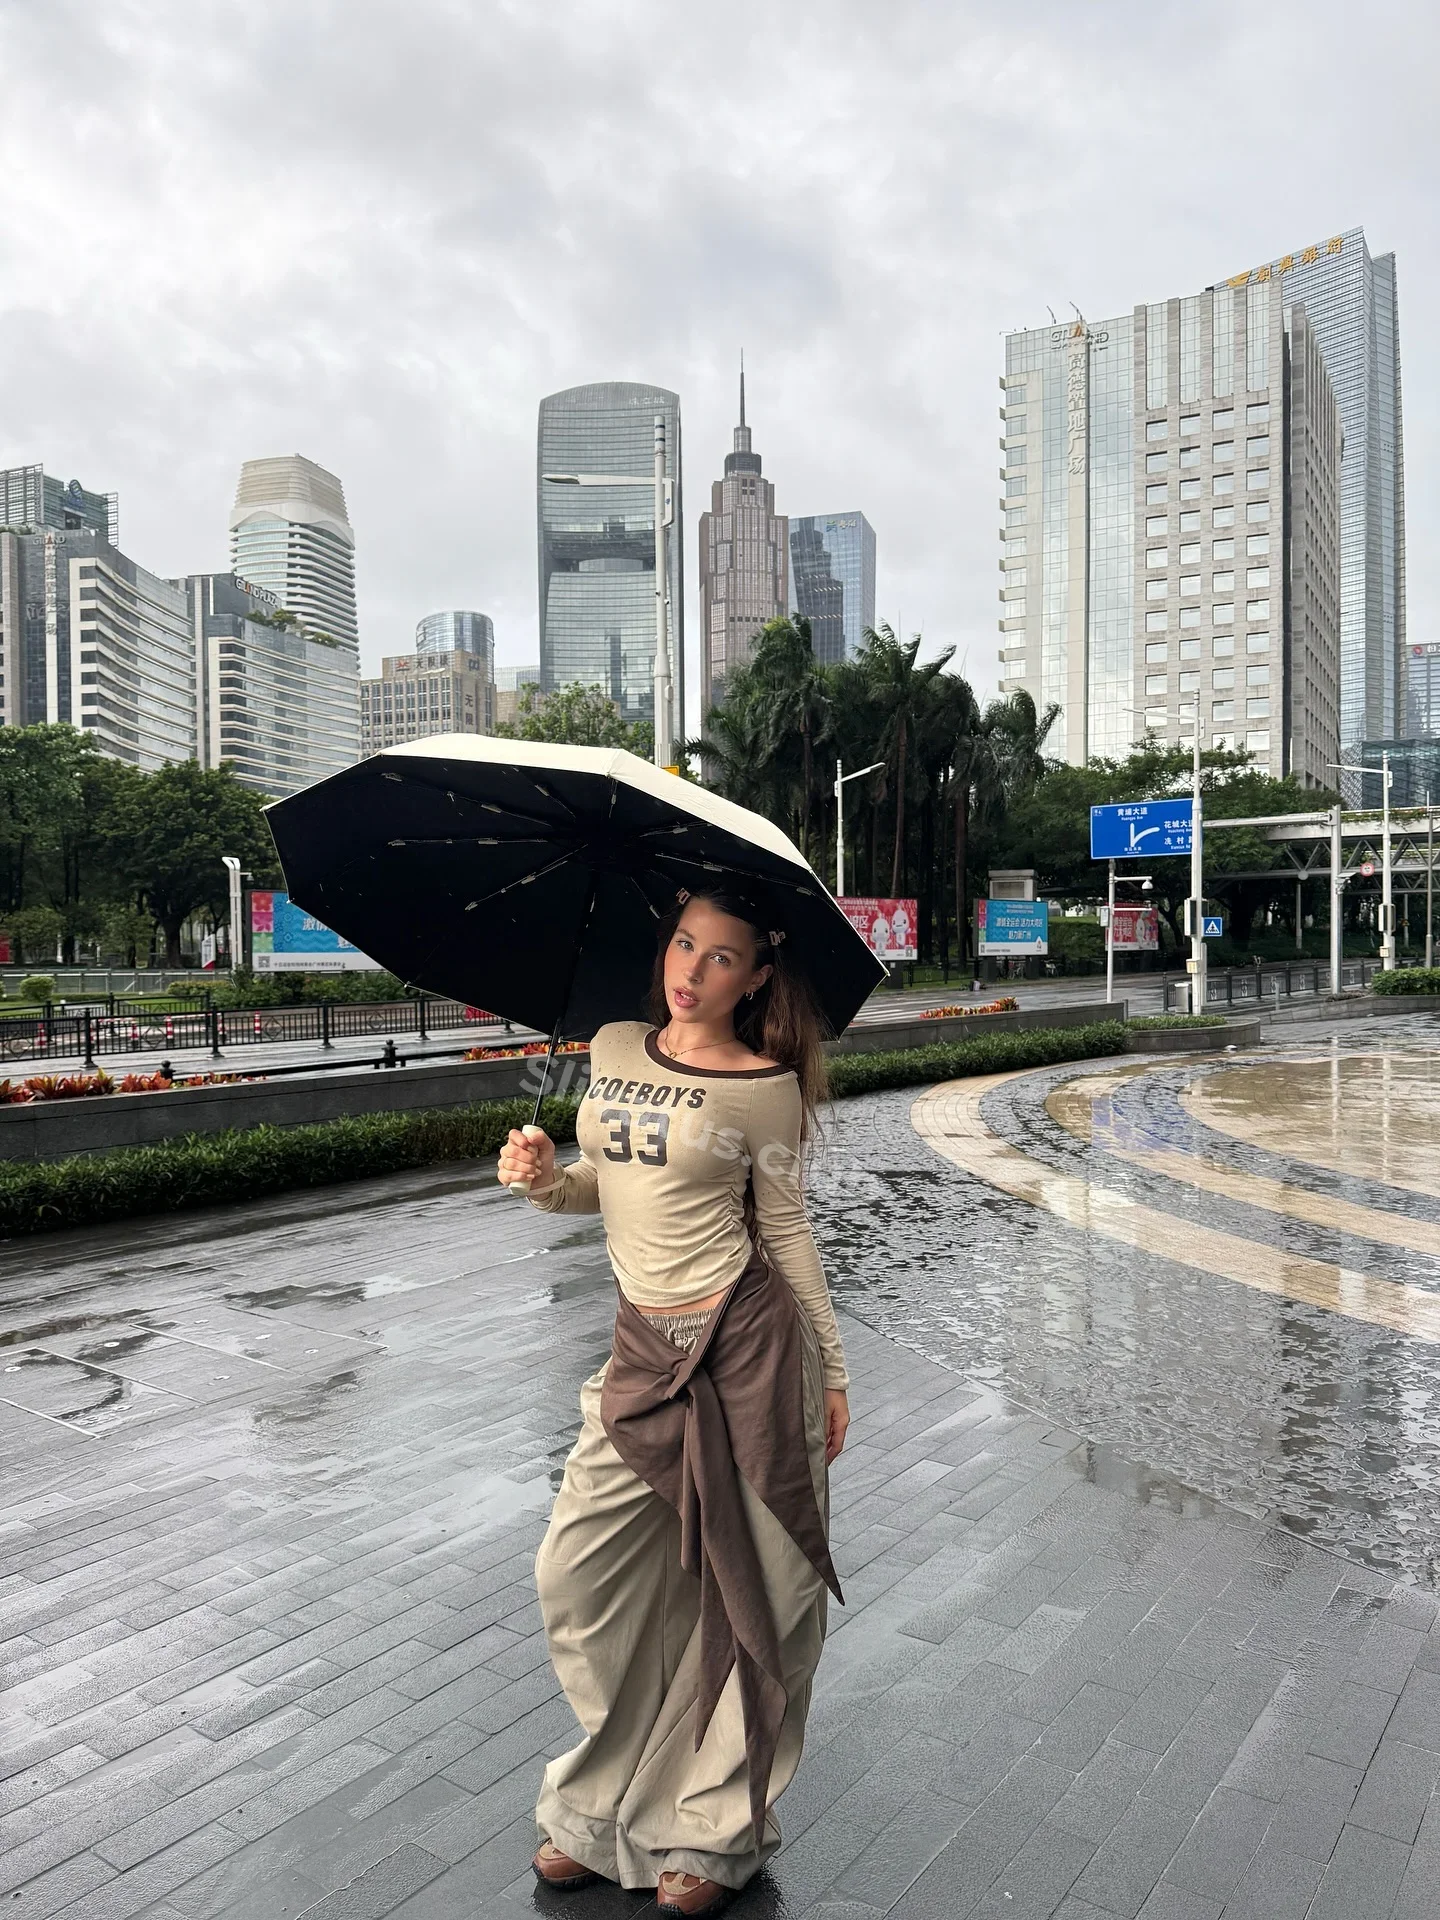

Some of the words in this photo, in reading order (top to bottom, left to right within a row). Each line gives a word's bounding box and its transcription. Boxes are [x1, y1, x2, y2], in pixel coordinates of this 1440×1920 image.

[464, 694, 474, 733] 无限
[1117, 807, 1148, 817] 黄埔大道
[588, 1076, 707, 1109] COEBOYS
[599, 1108, 671, 1167] 33
